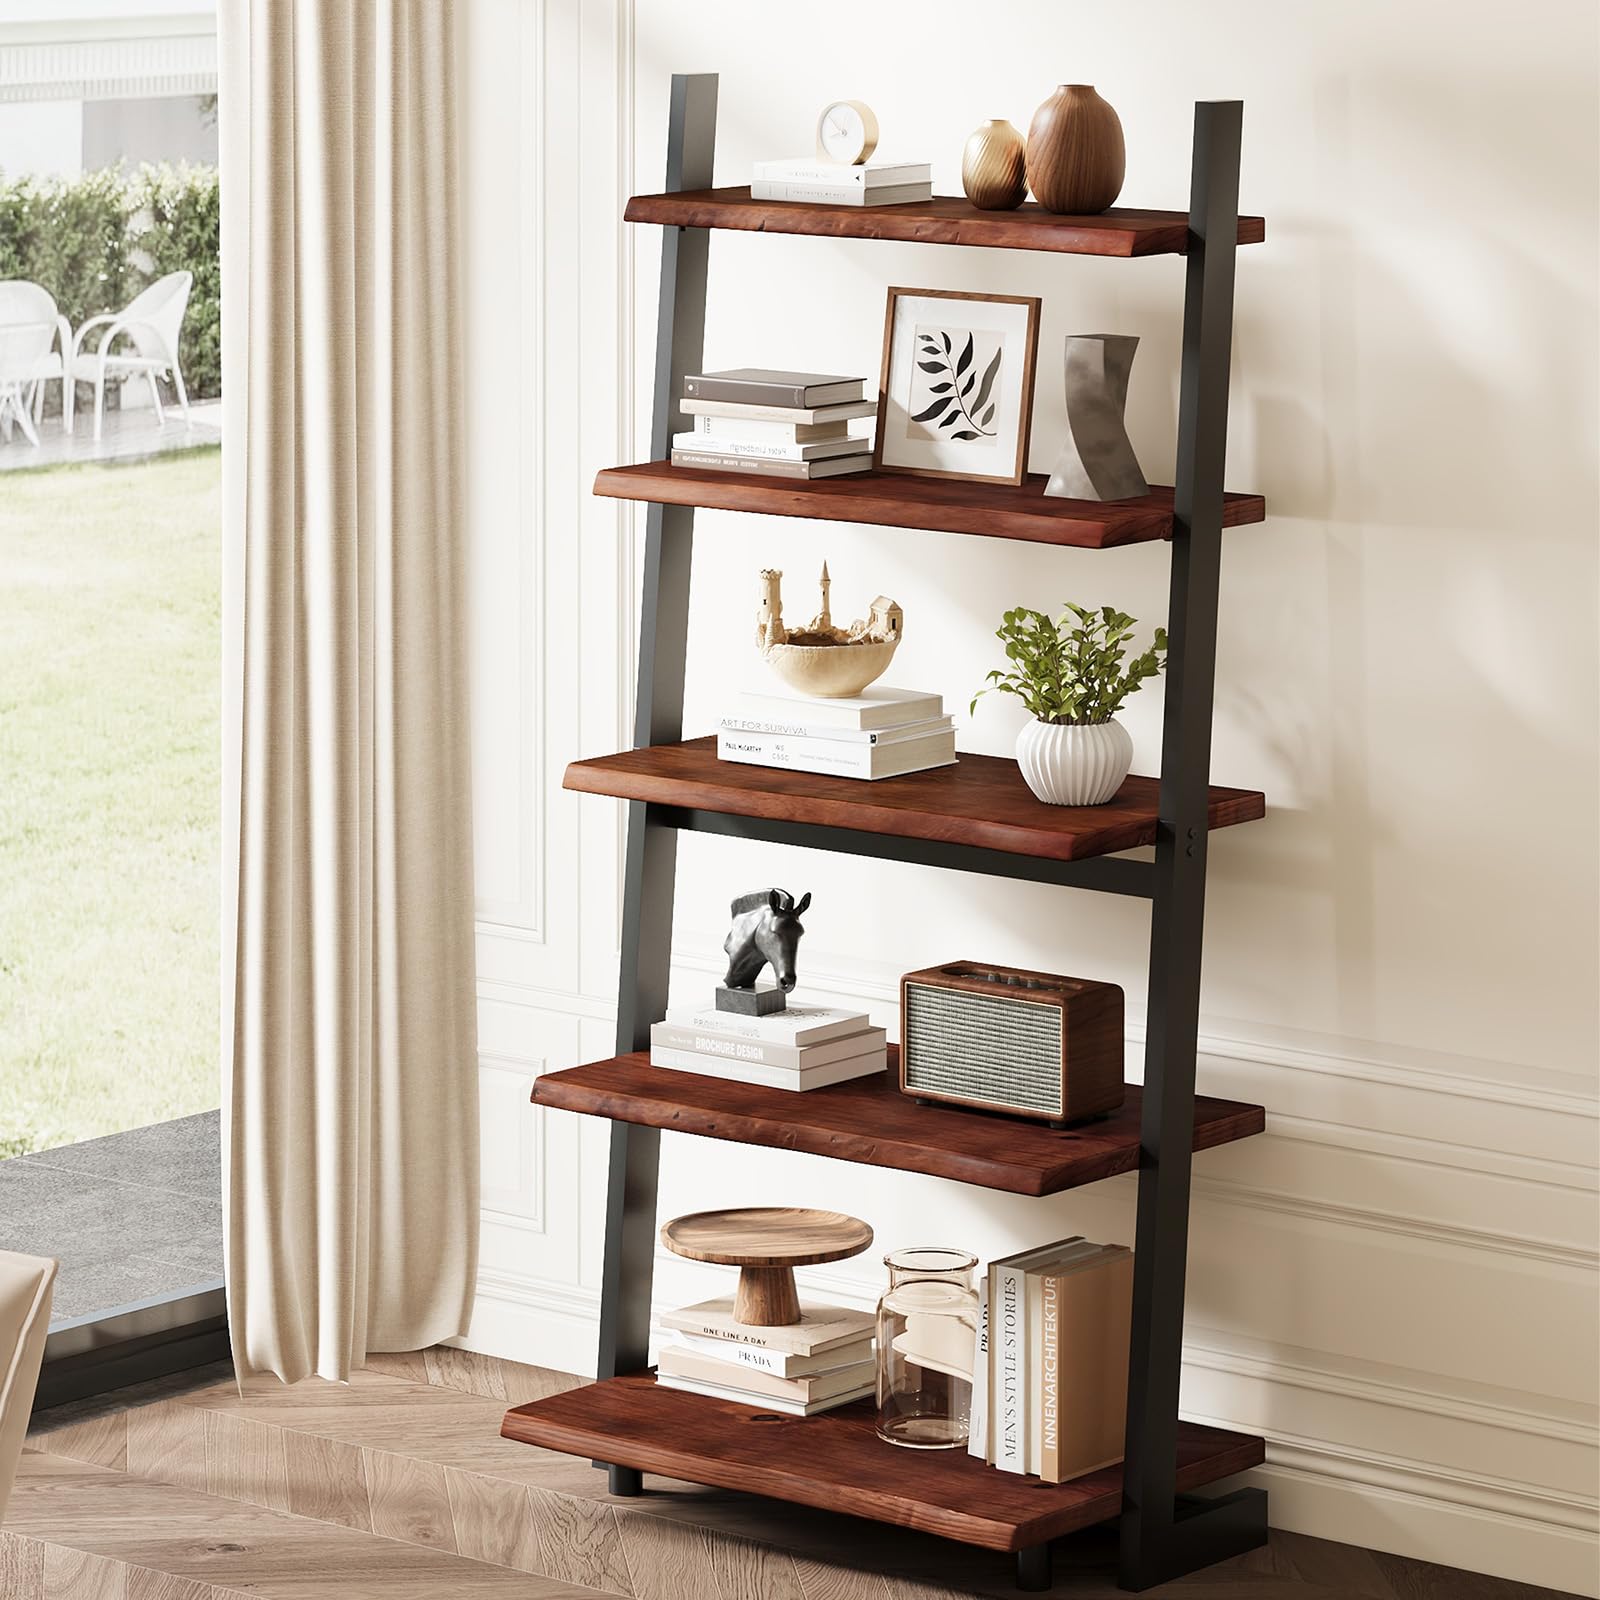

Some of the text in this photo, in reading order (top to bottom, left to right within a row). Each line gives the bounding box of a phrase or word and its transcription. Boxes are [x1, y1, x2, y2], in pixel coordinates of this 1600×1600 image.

[720, 718, 808, 736] ART FOR SURVIVAL
[725, 742, 737, 750] PAUL
[695, 1037, 735, 1055] BROCHURE
[736, 1042, 764, 1060] DESIGN
[703, 1327, 719, 1336] ONE
[722, 1331, 740, 1341] LINE
[750, 1337, 767, 1346] DAY
[738, 1350, 772, 1368] PRADA
[1004, 1277, 1017, 1459] MEN'S STYLE STORIES
[1044, 1277, 1057, 1450] INNENARCHITEKTUR
